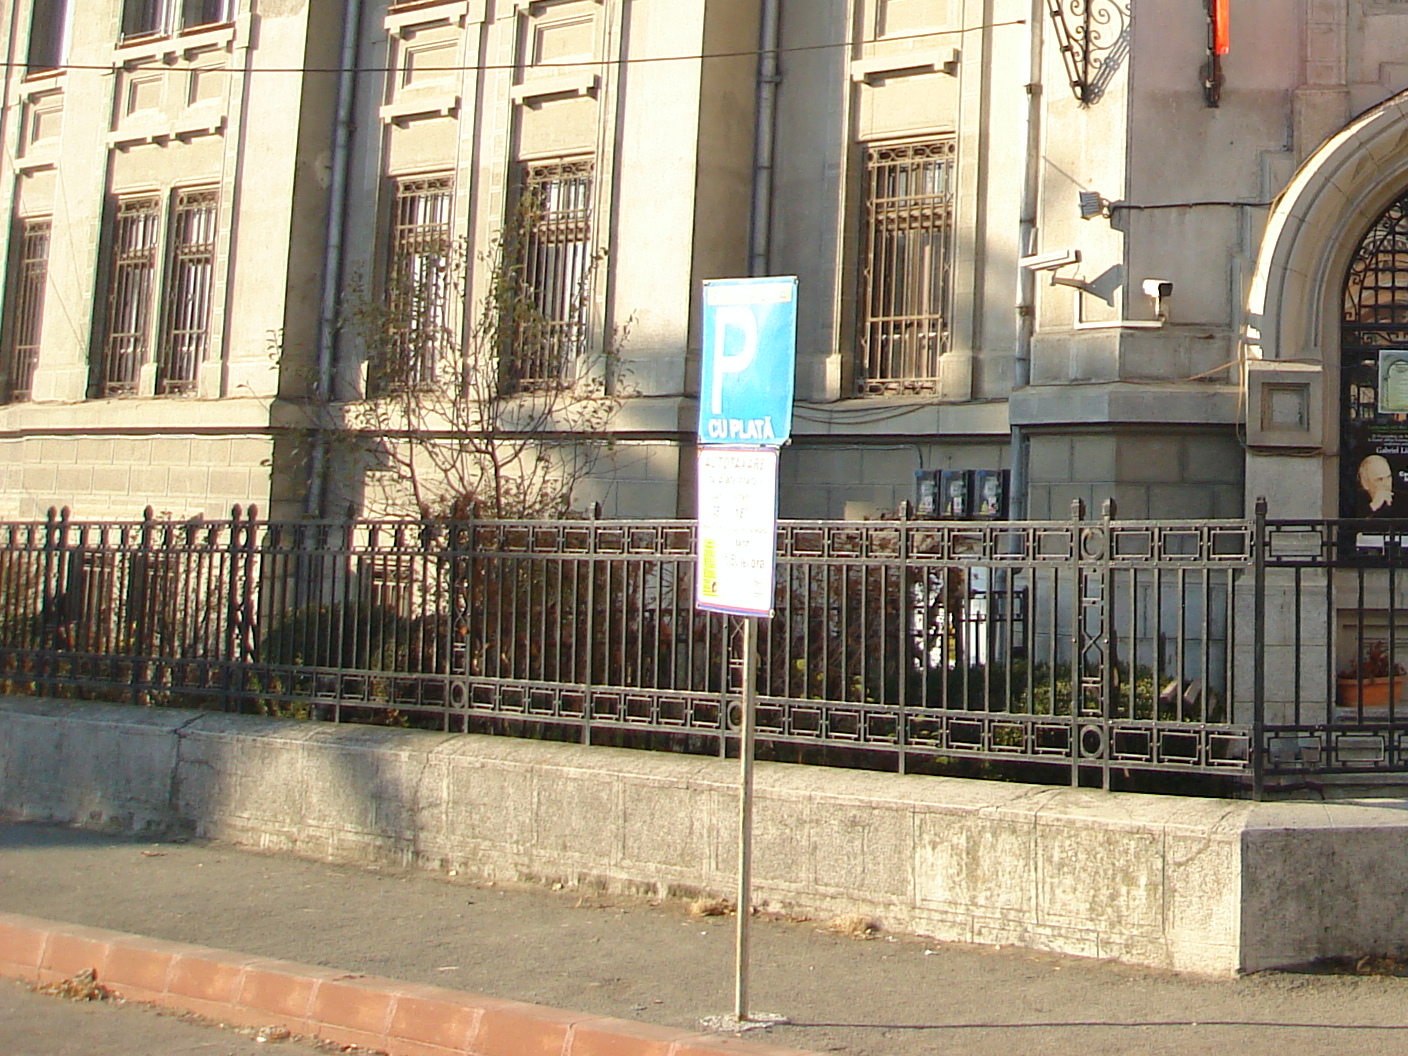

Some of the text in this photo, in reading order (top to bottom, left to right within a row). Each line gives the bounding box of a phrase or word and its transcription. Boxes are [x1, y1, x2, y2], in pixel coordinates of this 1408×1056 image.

[711, 306, 758, 415] P
[708, 416, 775, 440] CU PLATĂ
